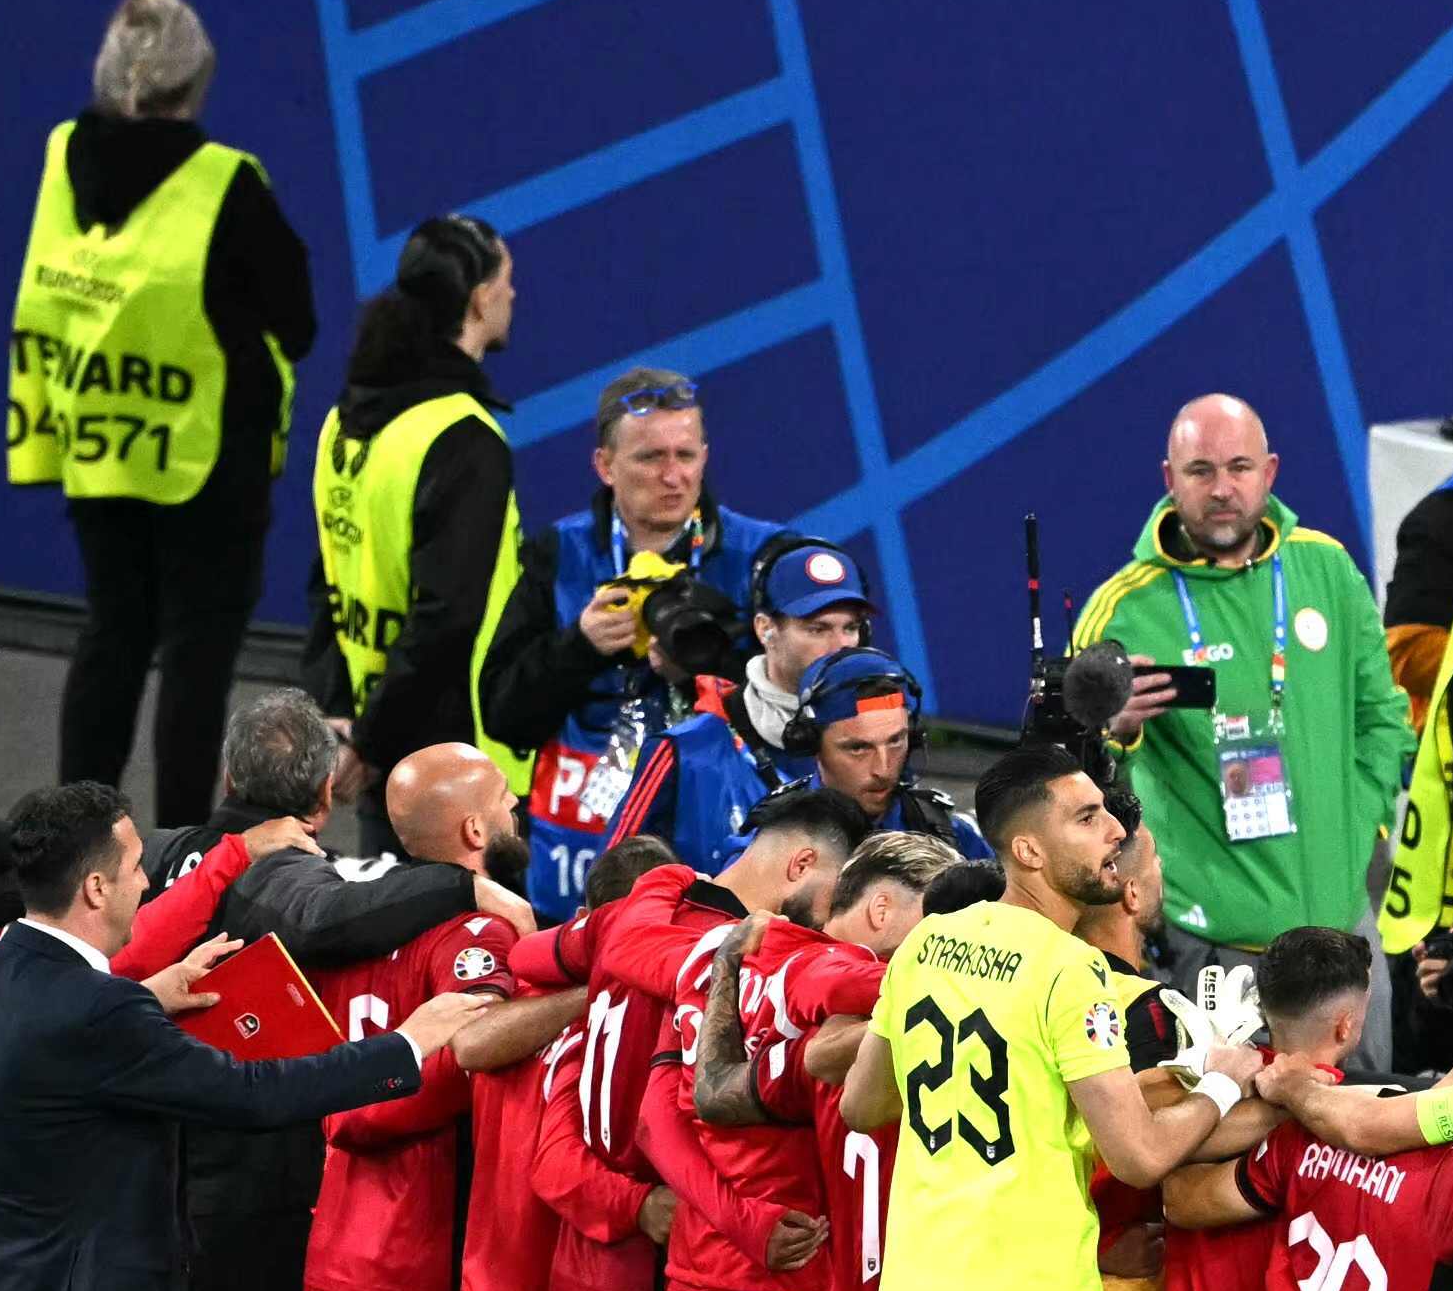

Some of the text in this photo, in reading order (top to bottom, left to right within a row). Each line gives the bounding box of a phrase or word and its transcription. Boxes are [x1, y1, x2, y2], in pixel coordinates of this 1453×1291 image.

[1182, 643, 1233, 666] EGO
[579, 988, 630, 1151] 11
[903, 995, 1017, 1167] 23
